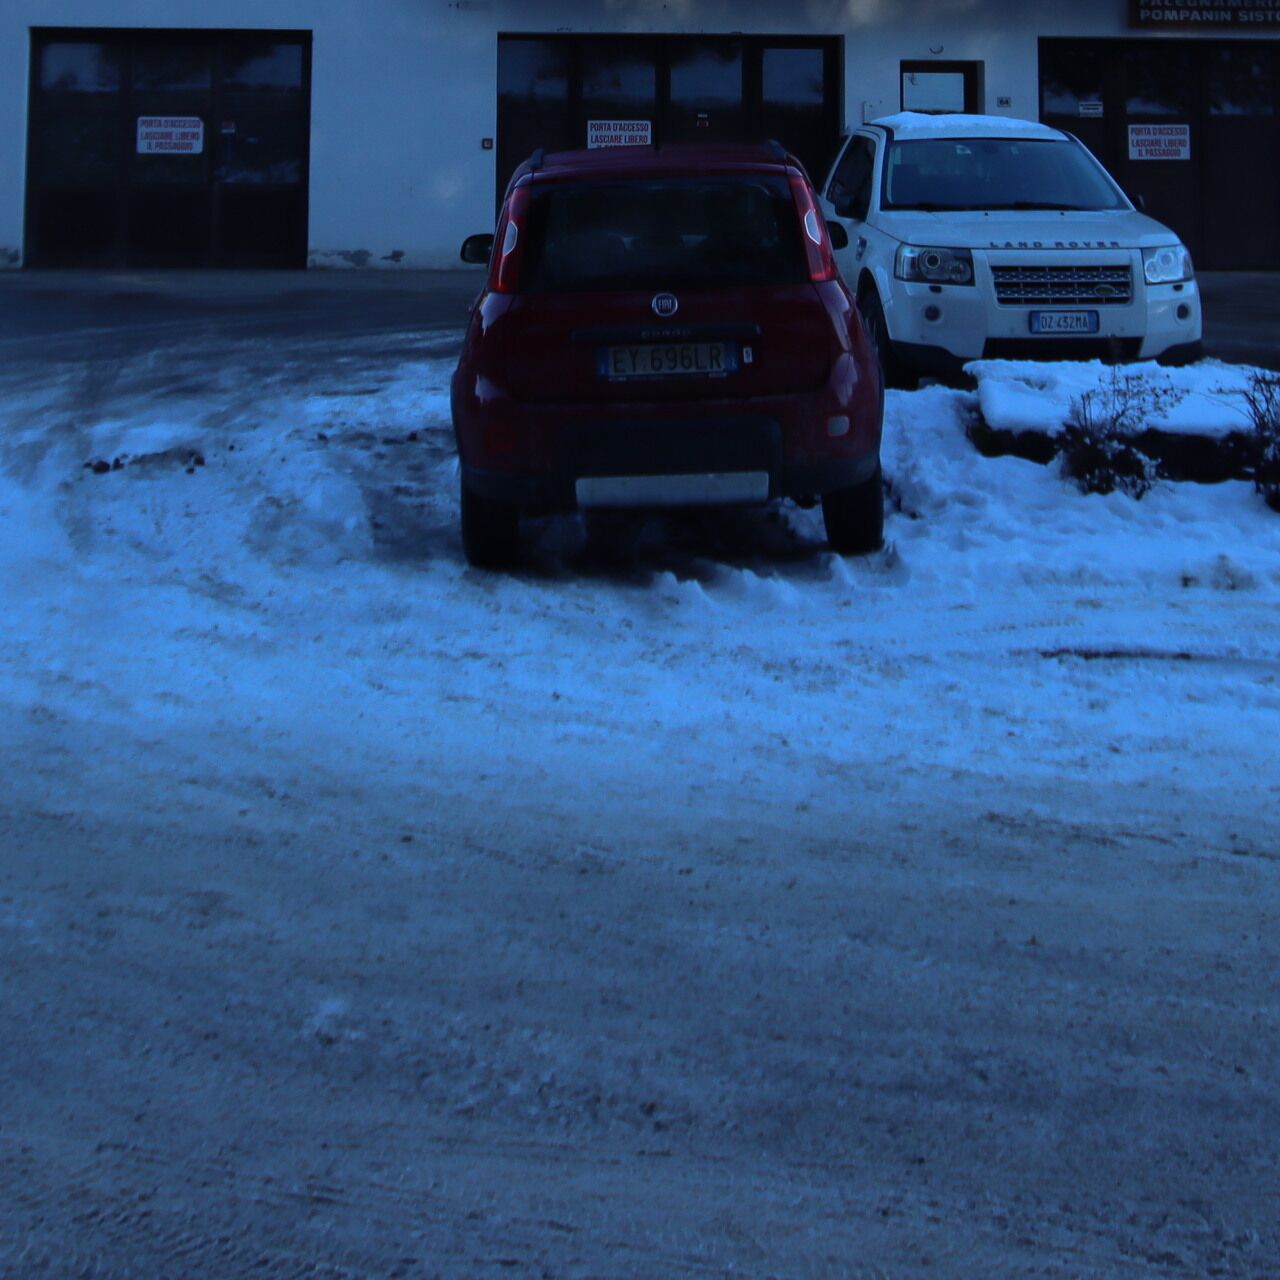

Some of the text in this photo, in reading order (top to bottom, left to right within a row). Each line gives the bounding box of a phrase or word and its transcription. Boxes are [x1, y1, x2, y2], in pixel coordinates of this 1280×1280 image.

[1140, 8, 1233, 22] POMPANIN
[589, 122, 648, 131] PORTA D'ACCESSO
[1131, 127, 1151, 136] PORTA
[590, 134, 648, 144] LASCIARE LIBERO
[990, 241, 1121, 249] LAND ROVER
[658, 298, 672, 311] FIAT
[613, 344, 722, 373] EY 696LR
